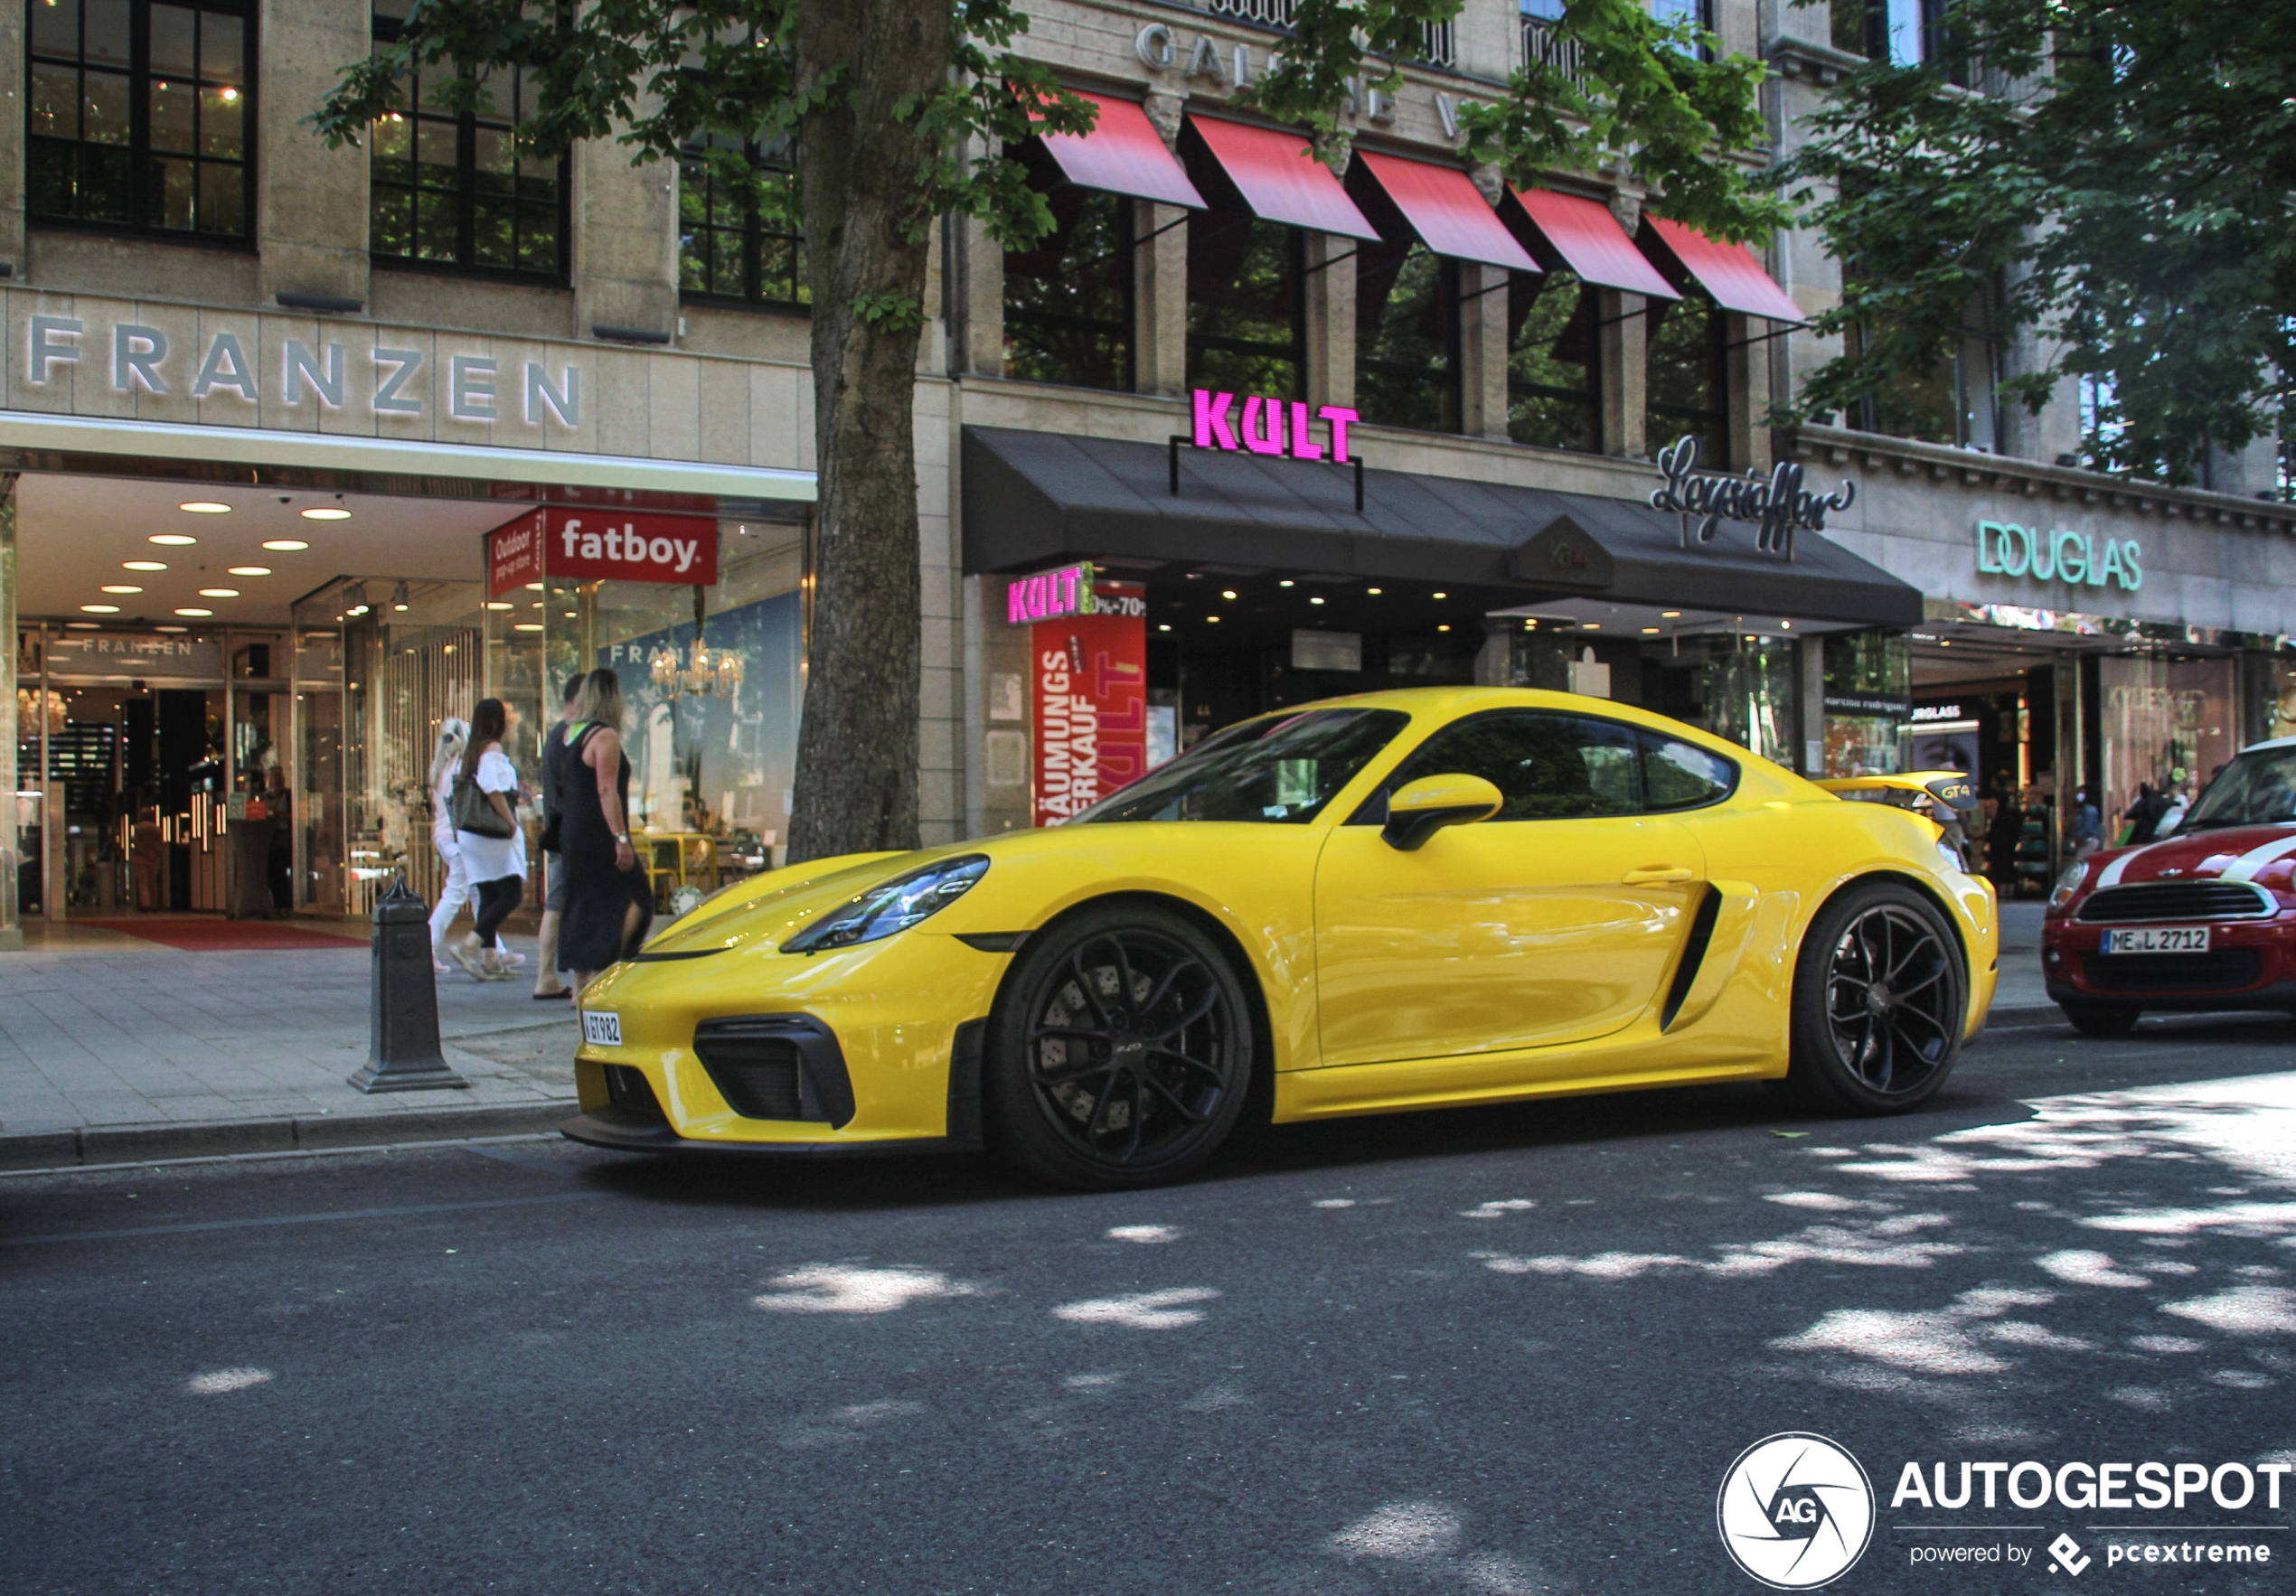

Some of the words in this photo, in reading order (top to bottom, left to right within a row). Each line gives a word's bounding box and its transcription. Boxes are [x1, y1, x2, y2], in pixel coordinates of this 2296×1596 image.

[29, 315, 580, 427] FRANZEN
[1192, 389, 1360, 463] KULT
[1650, 435, 1855, 553] Leysieffer
[561, 519, 697, 572] fatboy
[1976, 519, 2143, 592] DOUGLAS
[1007, 568, 1082, 624] KULT
[81, 638, 193, 656] FRANZEN
[1941, 784, 1971, 800] GT4
